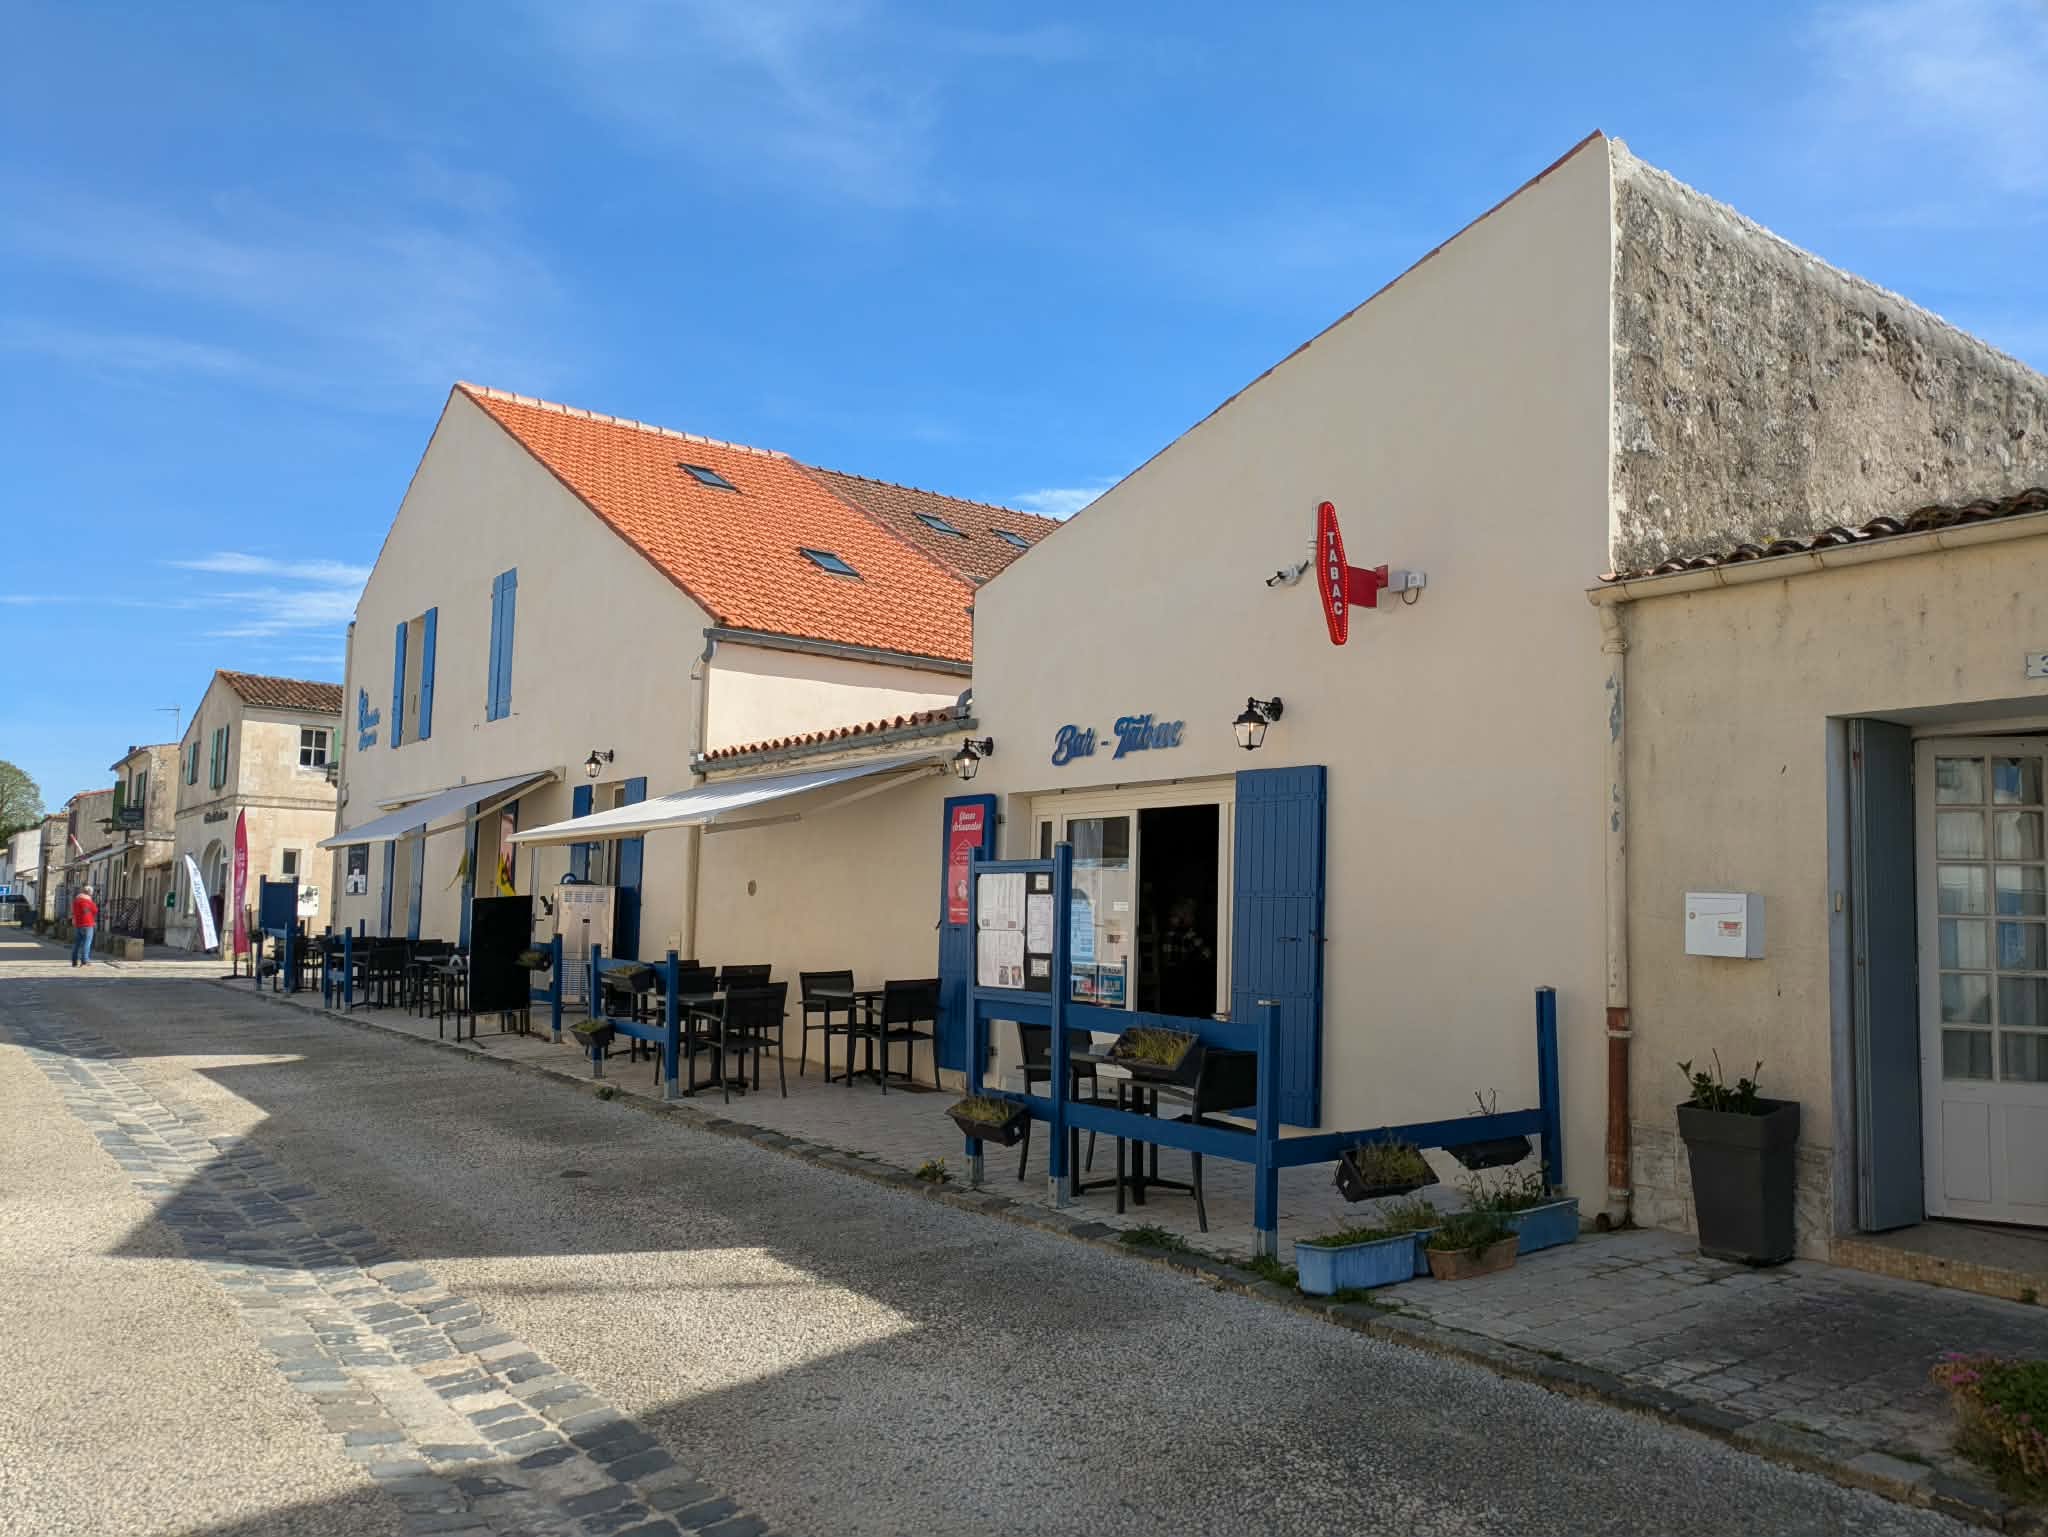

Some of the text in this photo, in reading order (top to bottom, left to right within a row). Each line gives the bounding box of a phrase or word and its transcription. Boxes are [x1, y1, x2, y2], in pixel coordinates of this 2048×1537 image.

[1326, 531, 1344, 615] TABAC
[1051, 725, 1096, 766] Bar
[1112, 713, 1184, 760] Tabac
